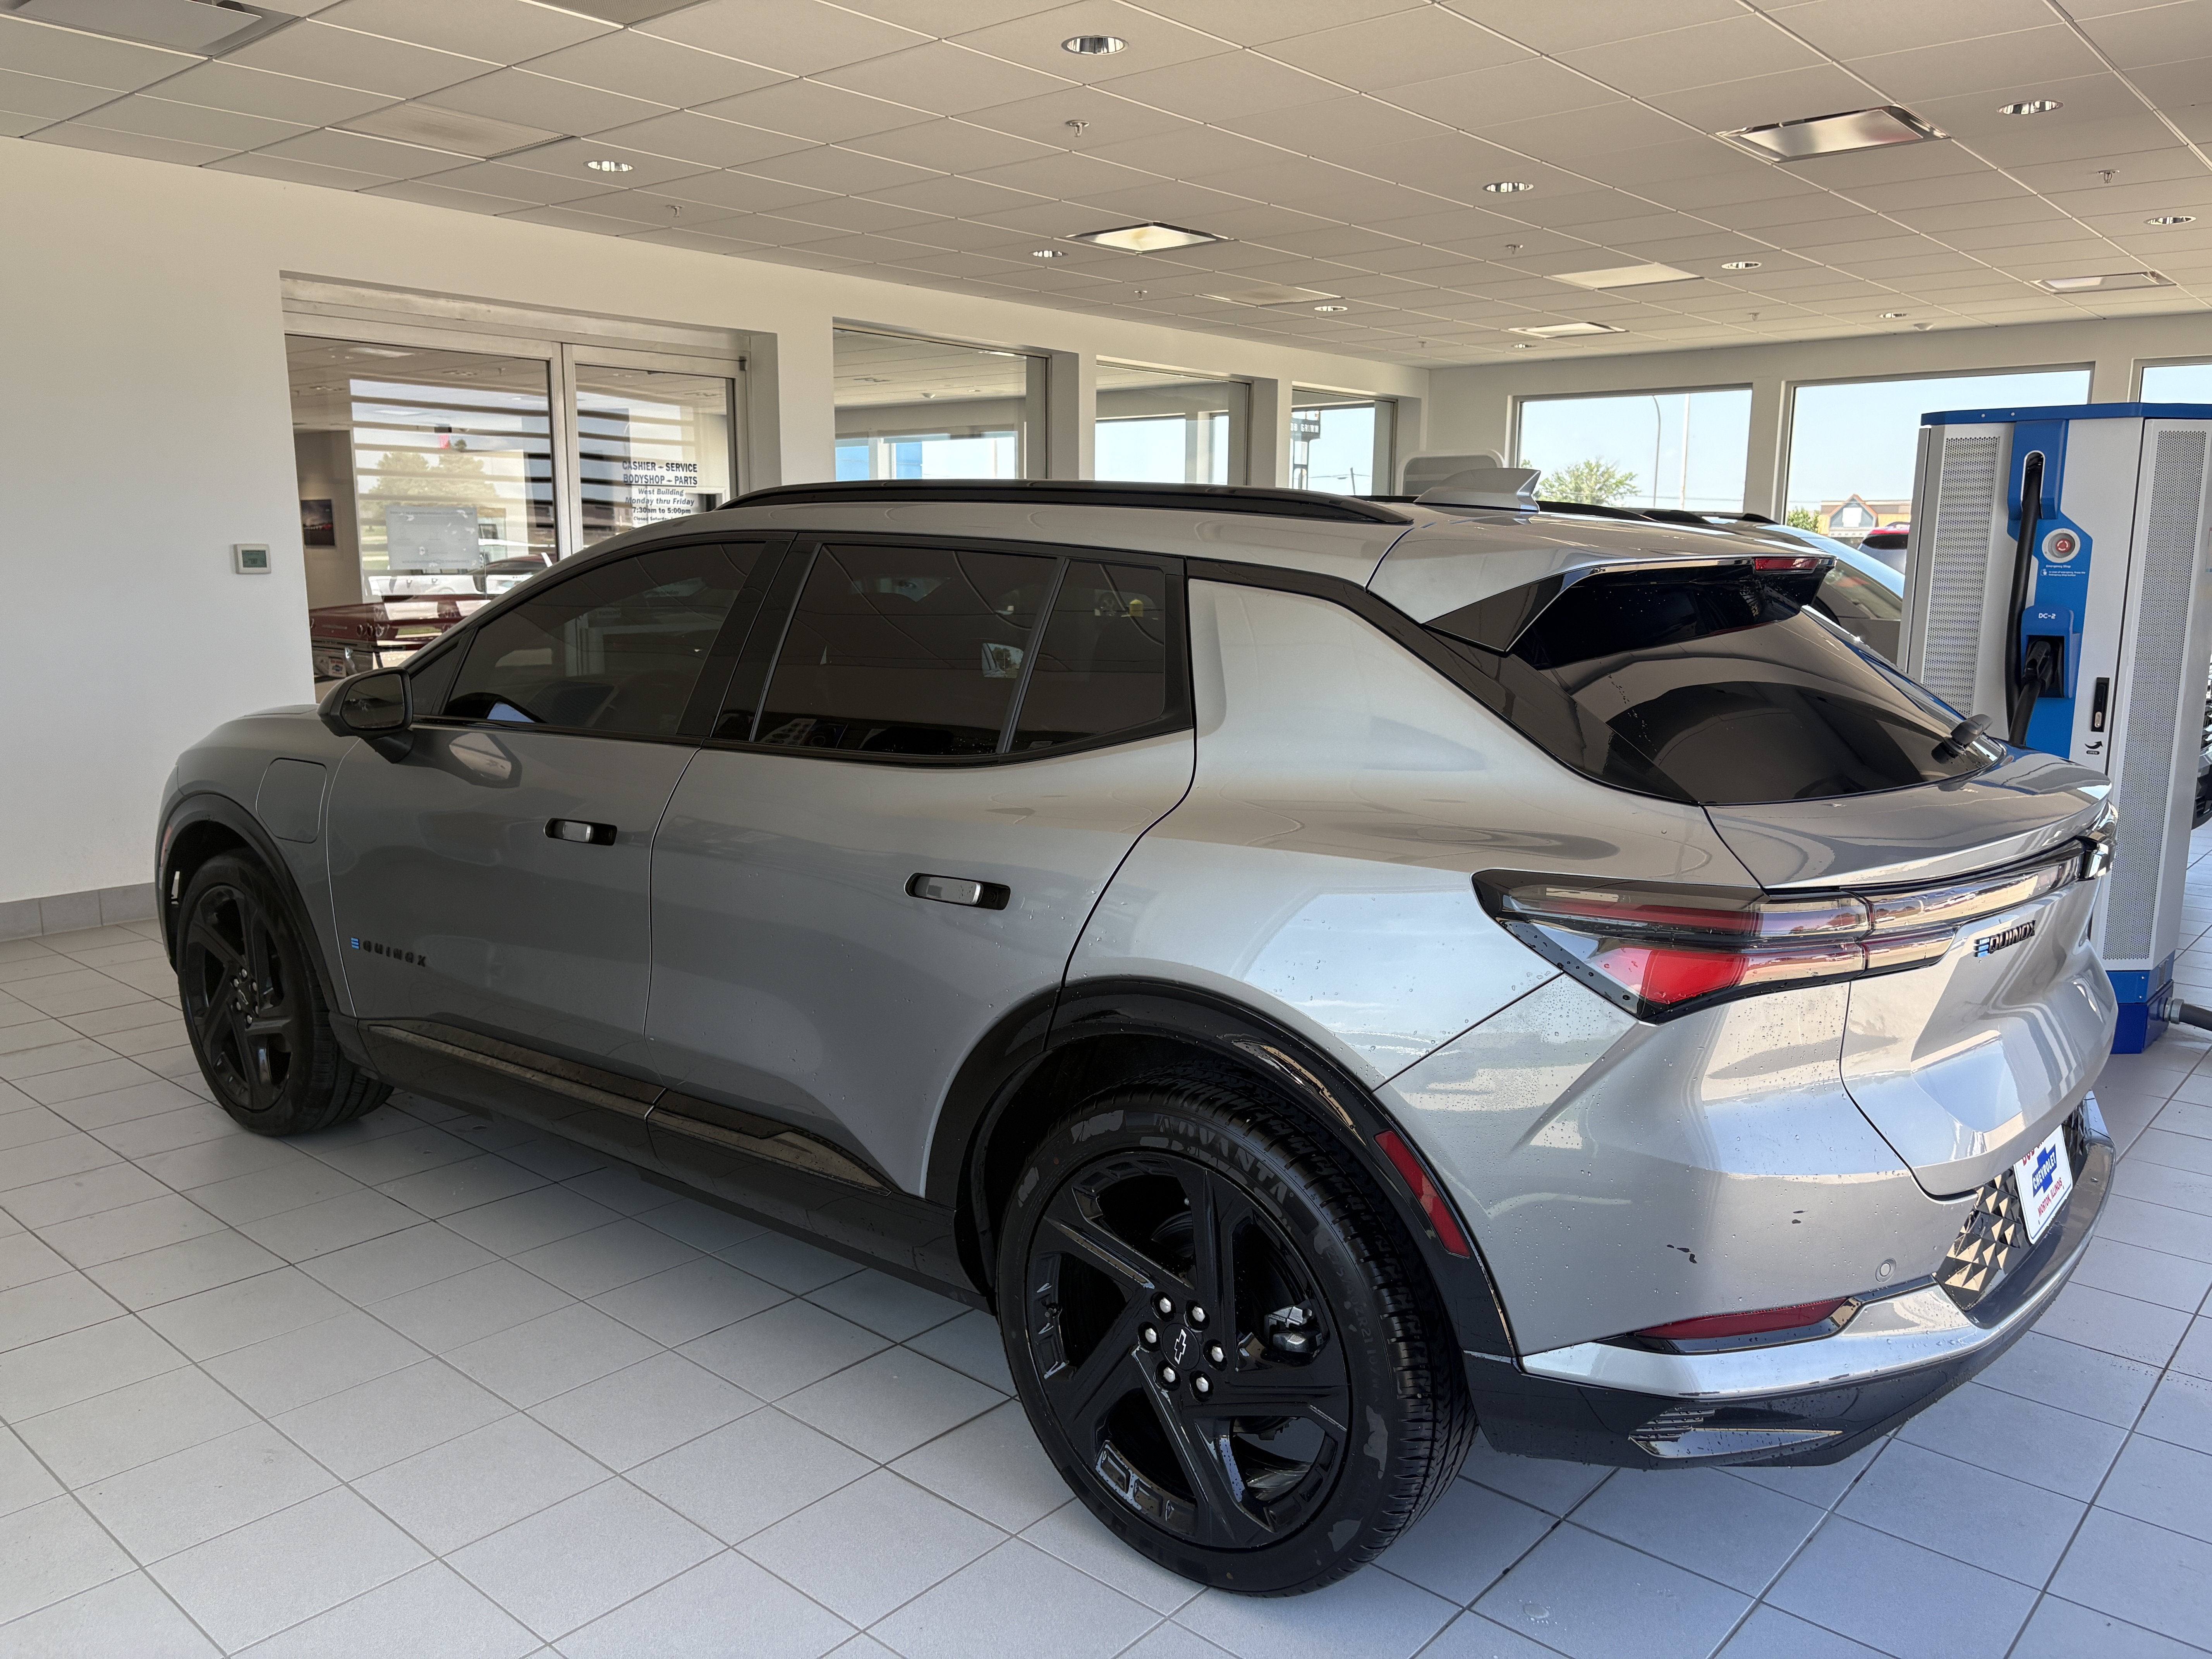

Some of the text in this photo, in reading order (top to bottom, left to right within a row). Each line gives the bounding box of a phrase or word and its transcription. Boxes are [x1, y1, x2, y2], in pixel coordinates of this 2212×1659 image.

[622, 461, 656, 471] CASHIER
[665, 462, 697, 472] SERVICE
[623, 474, 665, 484] BODYSHOP
[675, 476, 697, 485] PARTS
[657, 489, 684, 497] Building
[625, 496, 654, 506] Monday
[673, 498, 694, 507] Friday
[1973, 920, 2037, 958] EQUINOX
[2032, 1151, 2056, 1190] CHEVROLET
